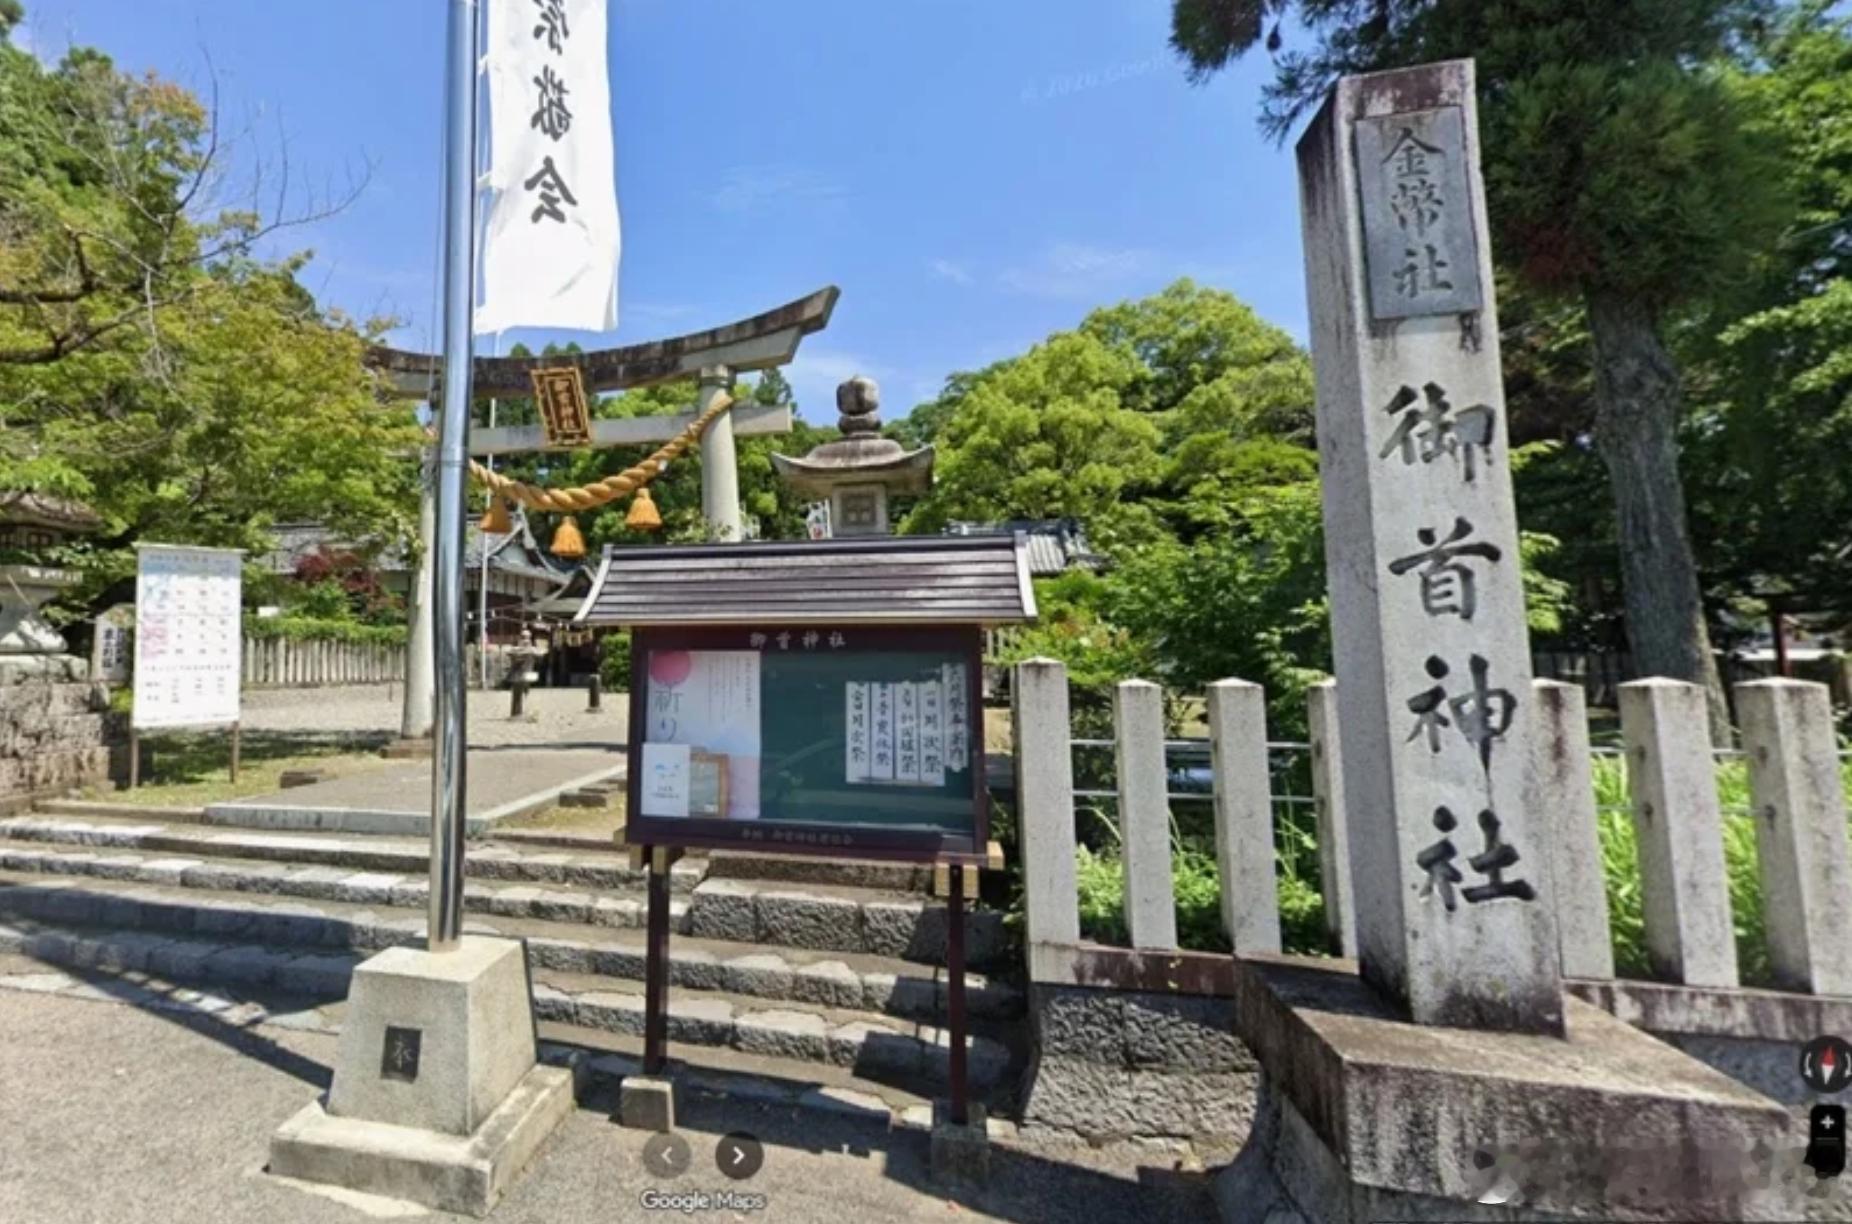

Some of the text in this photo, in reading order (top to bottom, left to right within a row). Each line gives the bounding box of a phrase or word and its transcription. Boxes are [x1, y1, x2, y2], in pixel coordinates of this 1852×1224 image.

[1380, 127, 1453, 298] 金幣社
[750, 630, 846, 650] 御首神社
[1380, 380, 1537, 912] 御首神社
